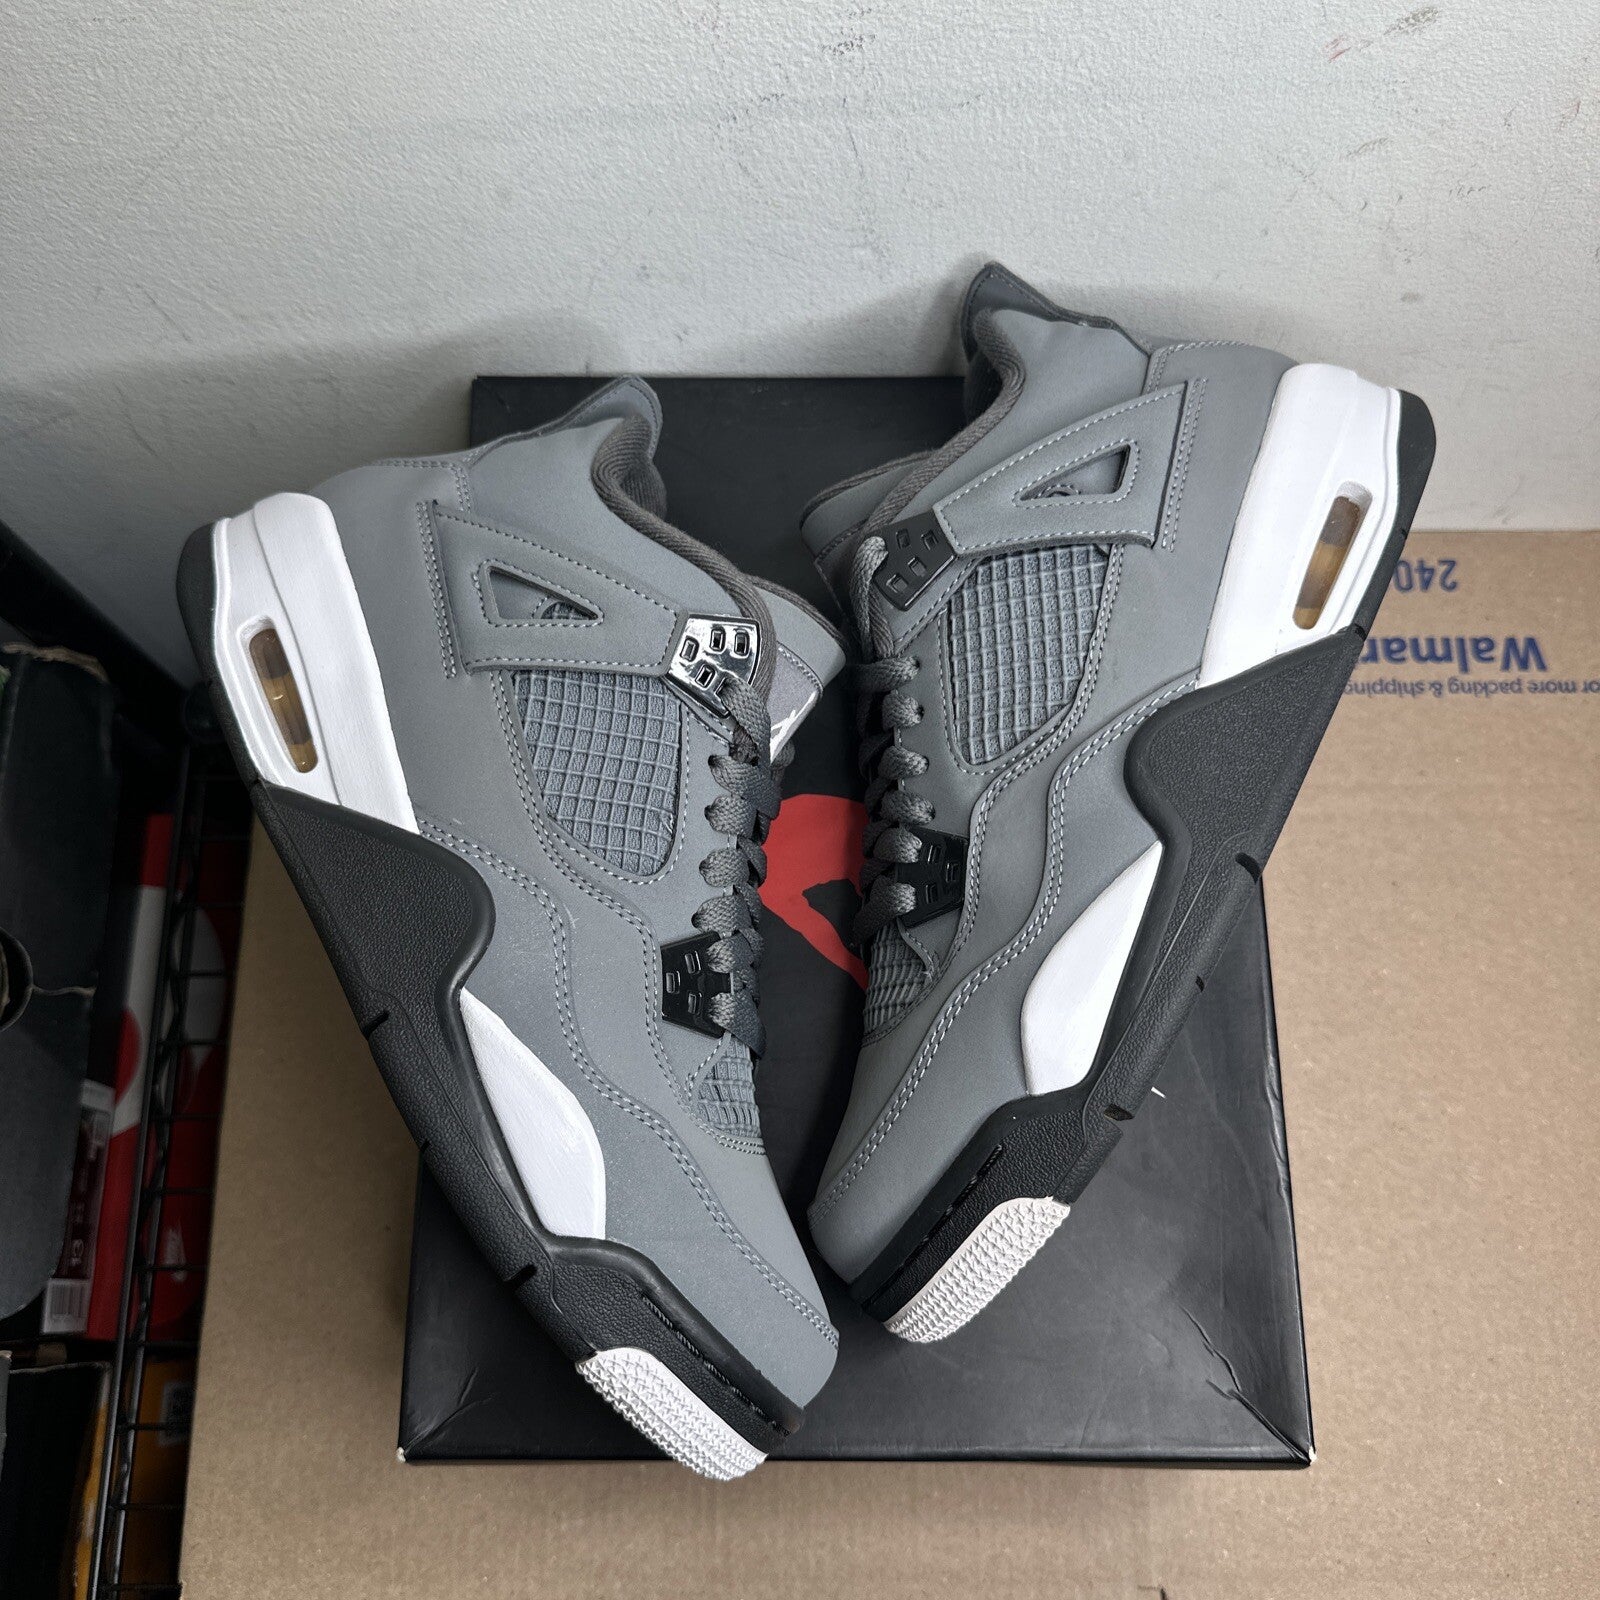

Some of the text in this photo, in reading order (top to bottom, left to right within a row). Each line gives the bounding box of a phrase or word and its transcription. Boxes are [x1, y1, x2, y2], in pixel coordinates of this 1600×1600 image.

[1391, 559, 1458, 593] 240
[1355, 636, 1547, 675] Walmar
[1430, 680, 1443, 695] &
[1448, 677, 1522, 698] packing
[1528, 680, 1577, 694] more
[1582, 681, 1600, 694] or
